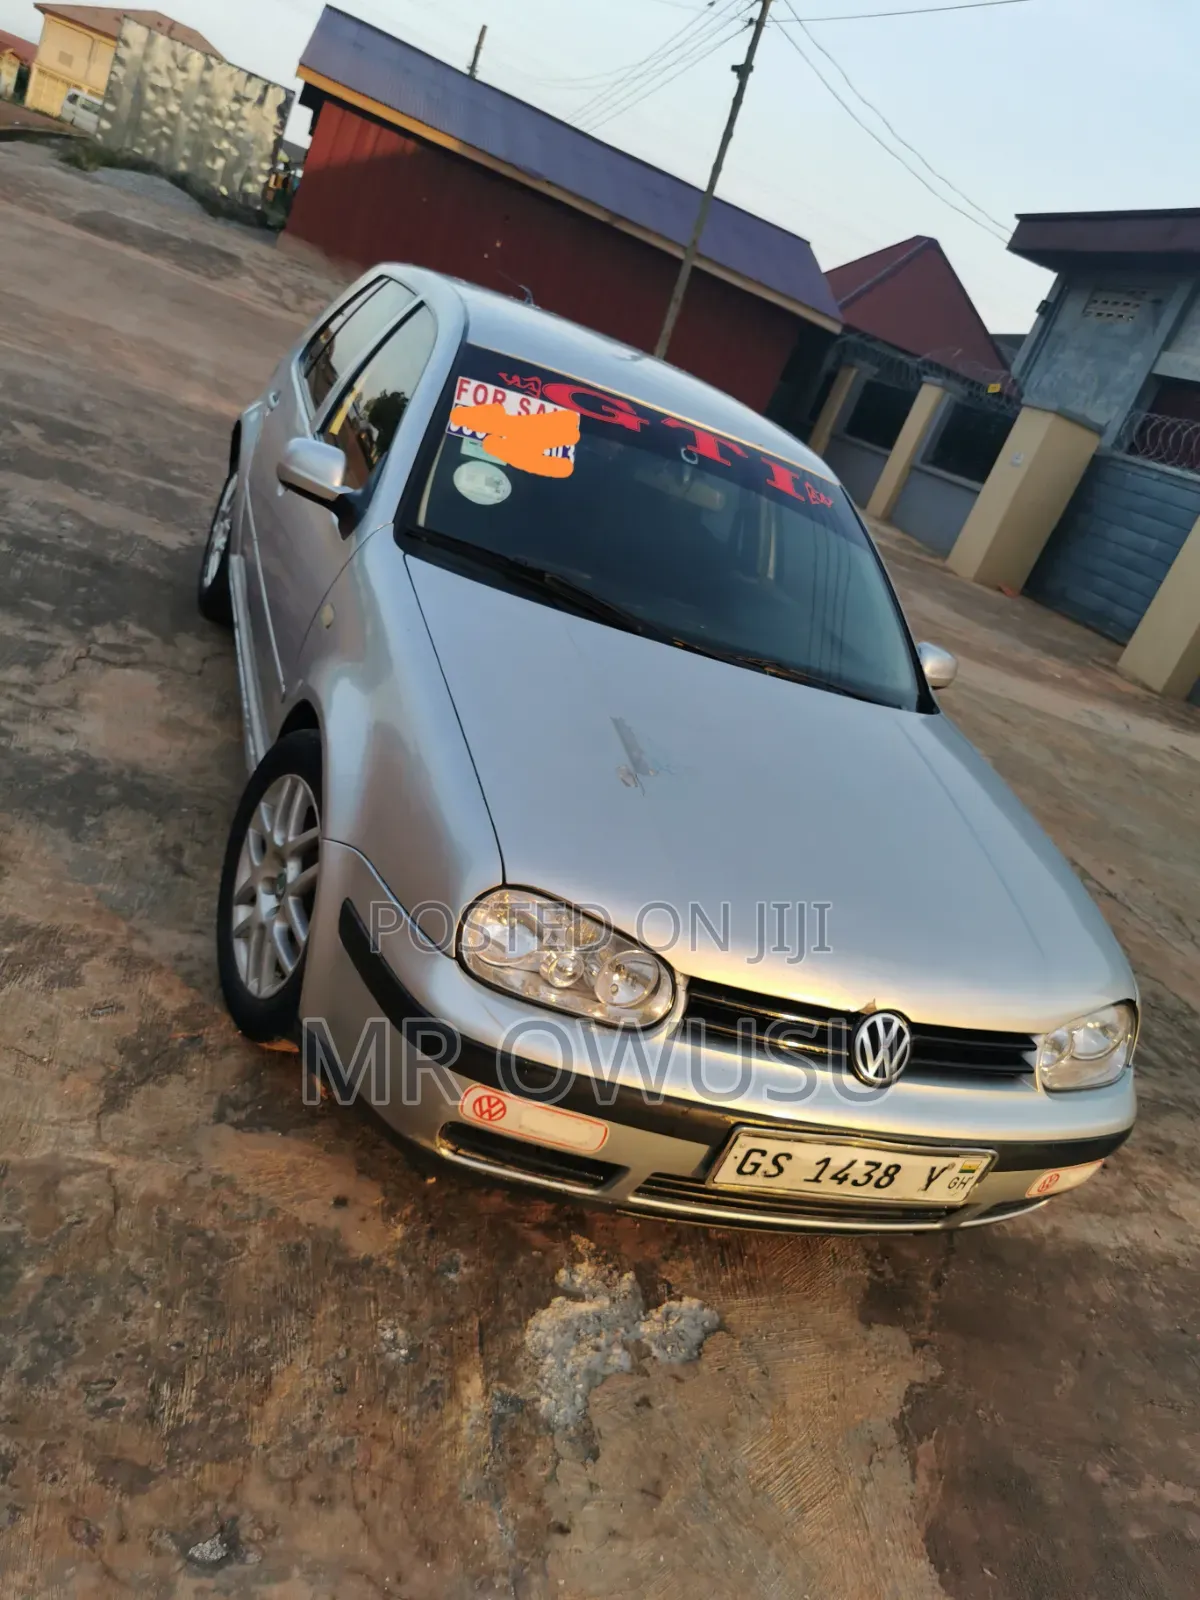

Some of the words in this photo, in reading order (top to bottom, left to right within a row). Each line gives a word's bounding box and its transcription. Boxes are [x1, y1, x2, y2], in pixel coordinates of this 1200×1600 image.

[456, 379, 507, 407] FOR
[542, 383, 805, 503] GTI
[855, 1012, 911, 1083] VW
[736, 1148, 793, 1178] GS
[803, 1157, 902, 1190] 1438
[922, 1164, 951, 1192] Y
[947, 1176, 974, 1191] GH
